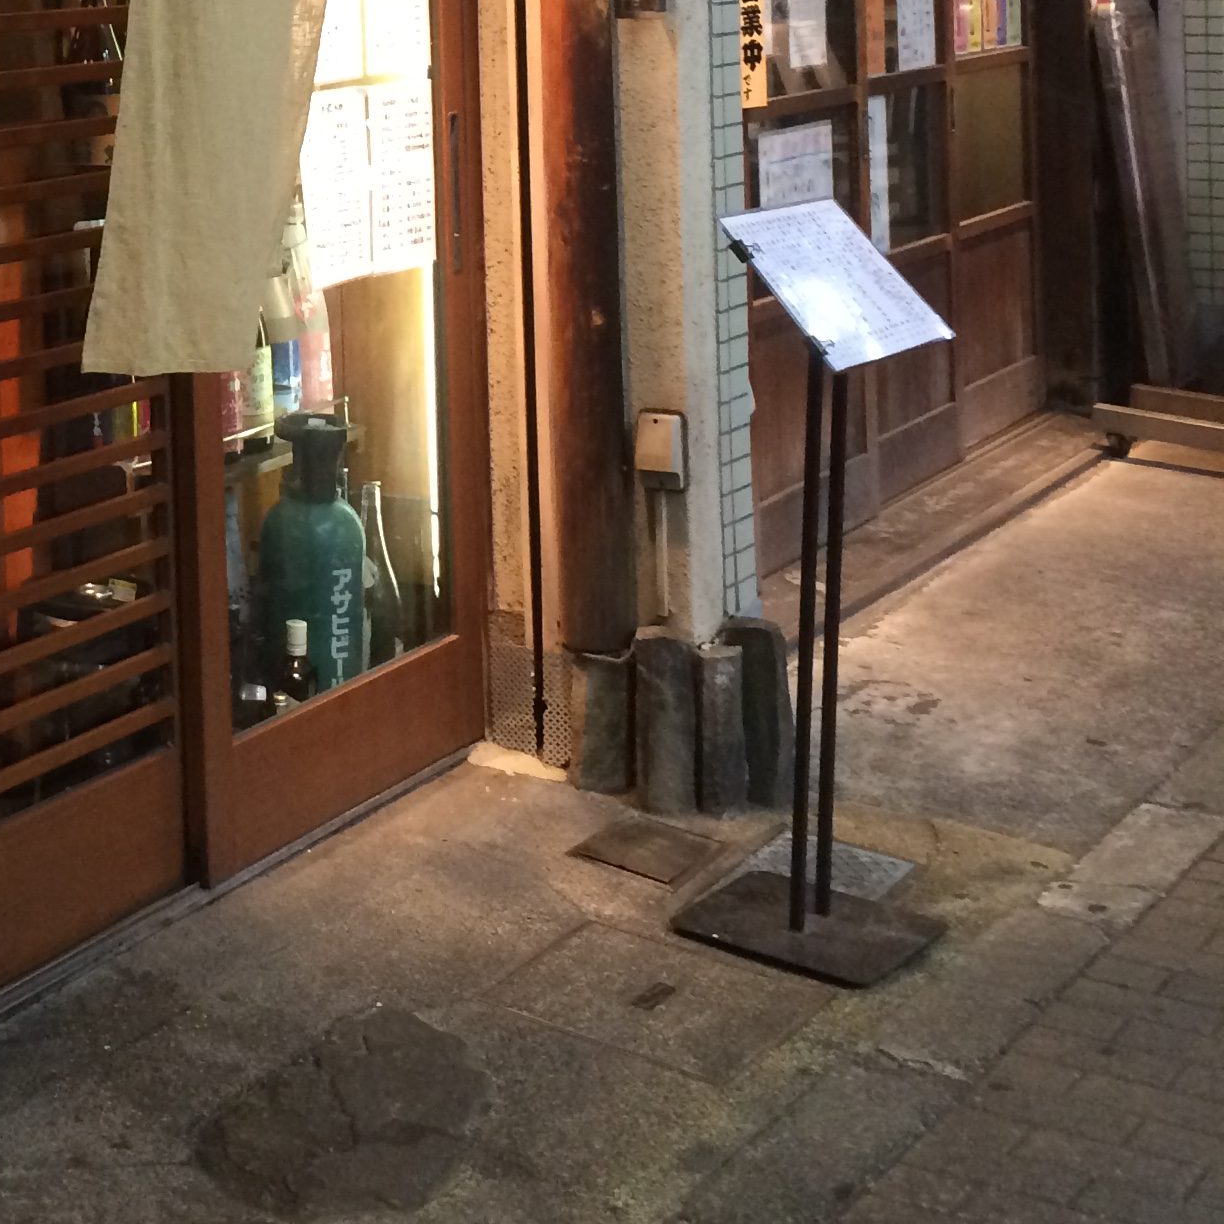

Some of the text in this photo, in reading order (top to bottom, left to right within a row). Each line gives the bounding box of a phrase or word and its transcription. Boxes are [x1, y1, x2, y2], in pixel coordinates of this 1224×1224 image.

[330, 568, 353, 687] アサヒビー
